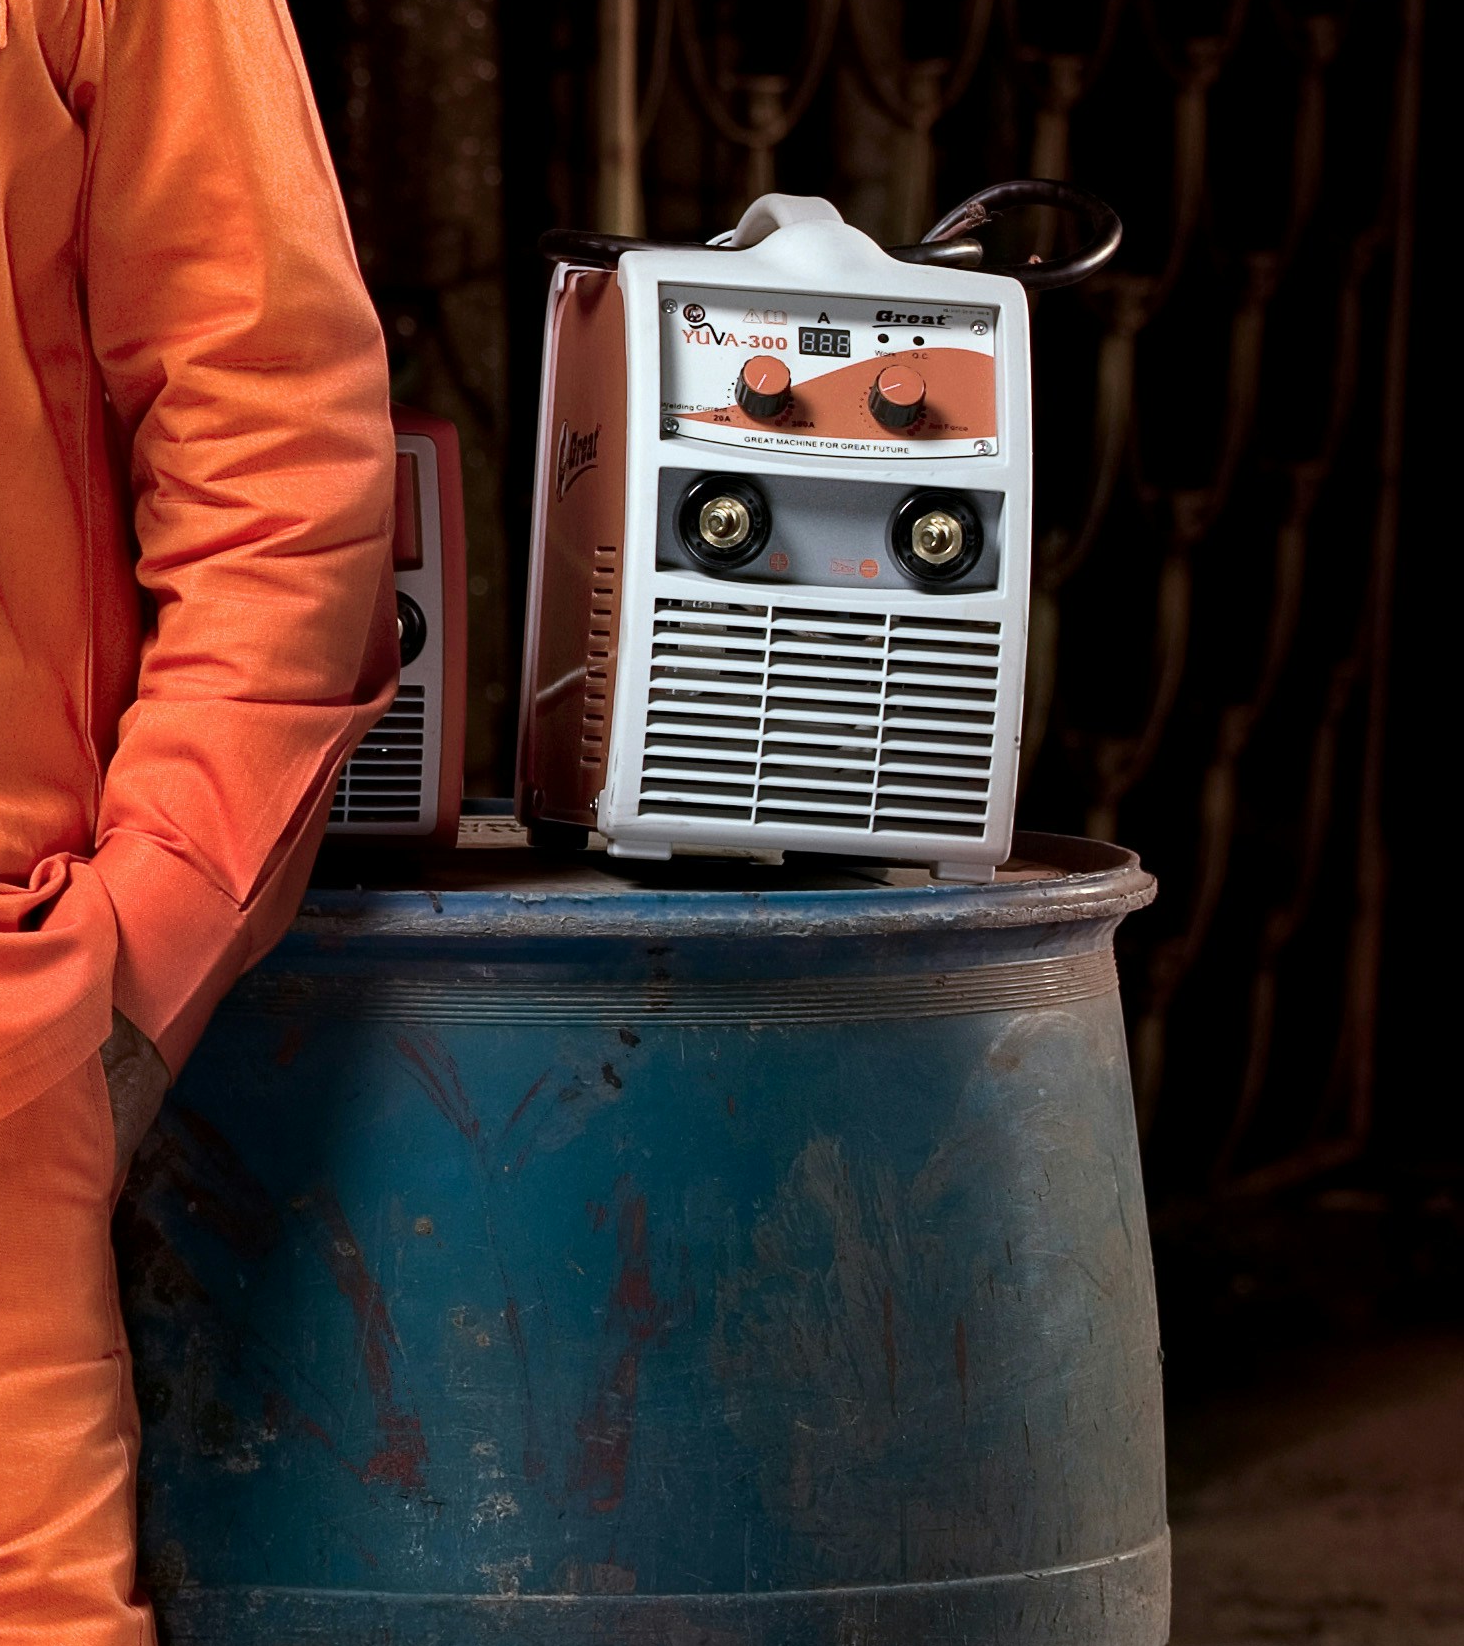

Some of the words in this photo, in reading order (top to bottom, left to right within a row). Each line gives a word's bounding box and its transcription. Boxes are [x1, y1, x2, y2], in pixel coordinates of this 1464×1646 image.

[818, 312, 831, 324] A
[875, 310, 947, 326] Great
[682, 322, 788, 351] YUVA-300
[744, 437, 773, 445] GREAT
[777, 439, 817, 448] MACHINE
[820, 441, 839, 449] FOR
[841, 443, 870, 451] GREAT
[873, 445, 910, 454] FUTURE
